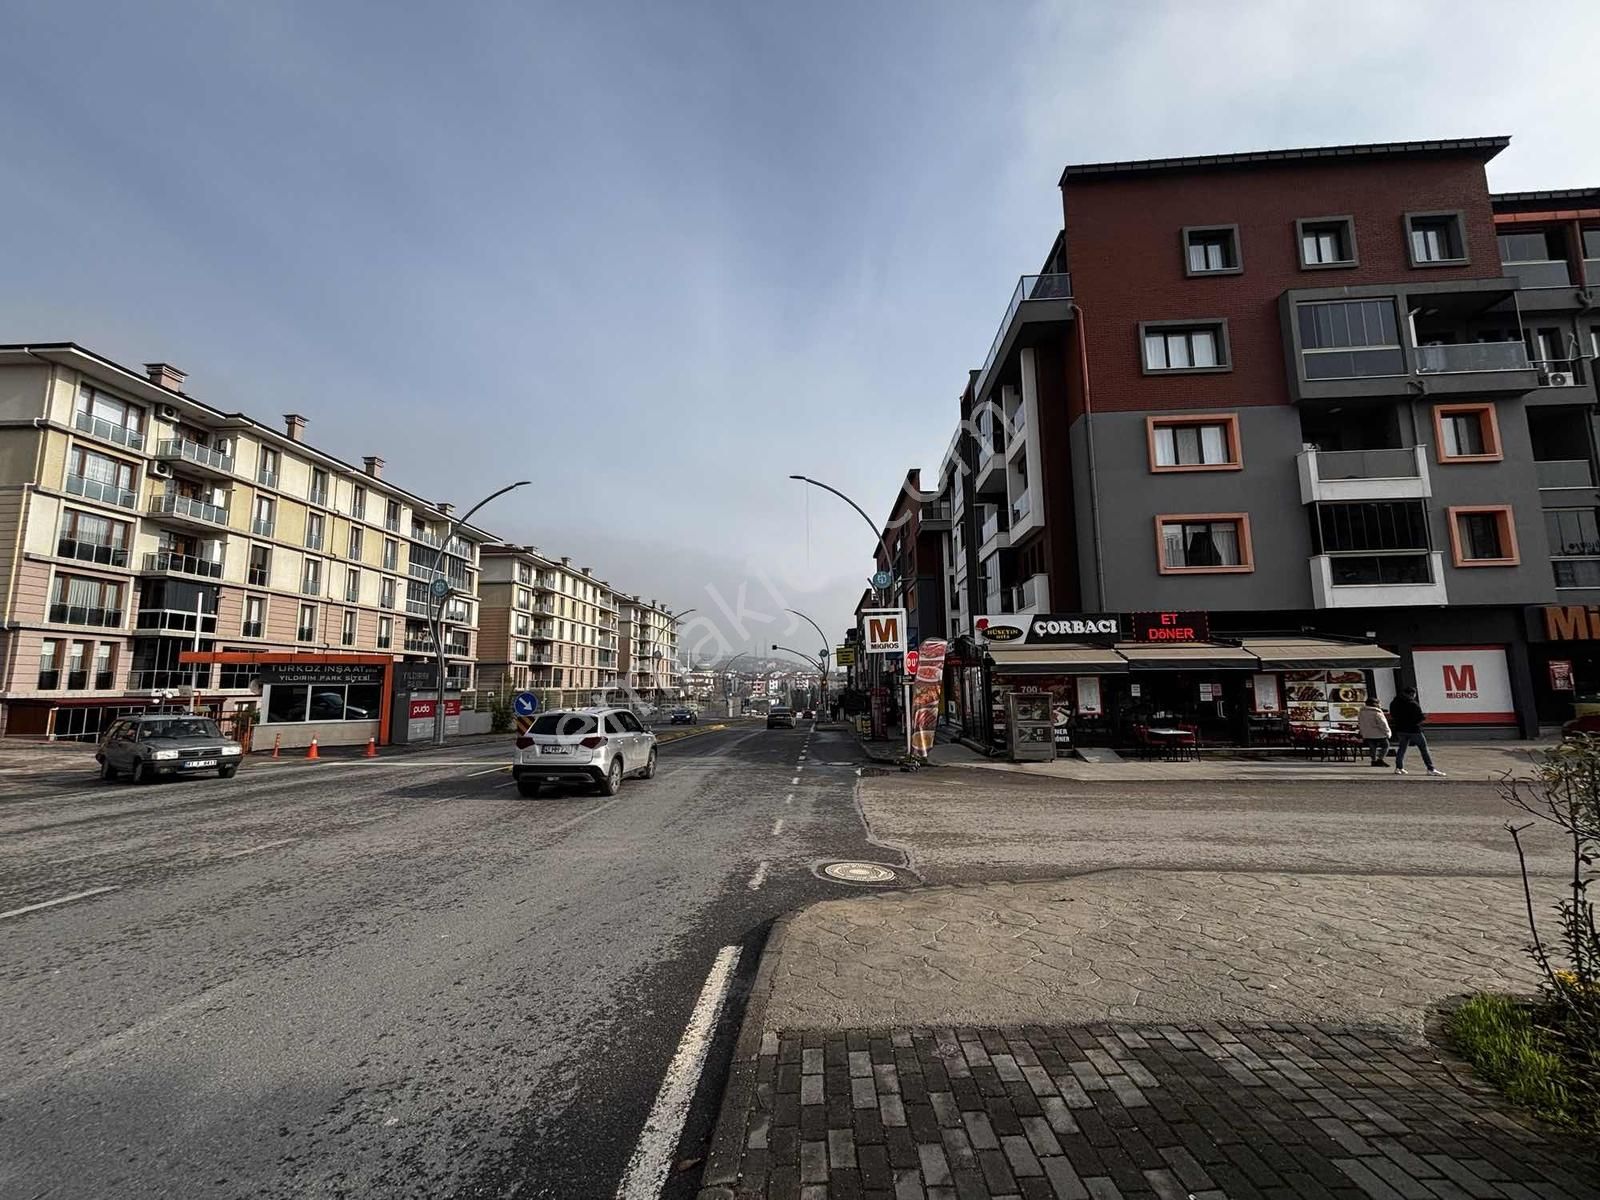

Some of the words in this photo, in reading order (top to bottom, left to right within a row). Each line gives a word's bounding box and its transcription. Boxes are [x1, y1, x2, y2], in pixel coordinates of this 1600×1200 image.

[1161, 613, 1179, 626] ET
[869, 618, 899, 643] M
[1034, 619, 1118, 637] ÇORBACI
[907, 658, 918, 667] DU
[1442, 664, 1477, 691] M
[413, 704, 430, 715] pudo
